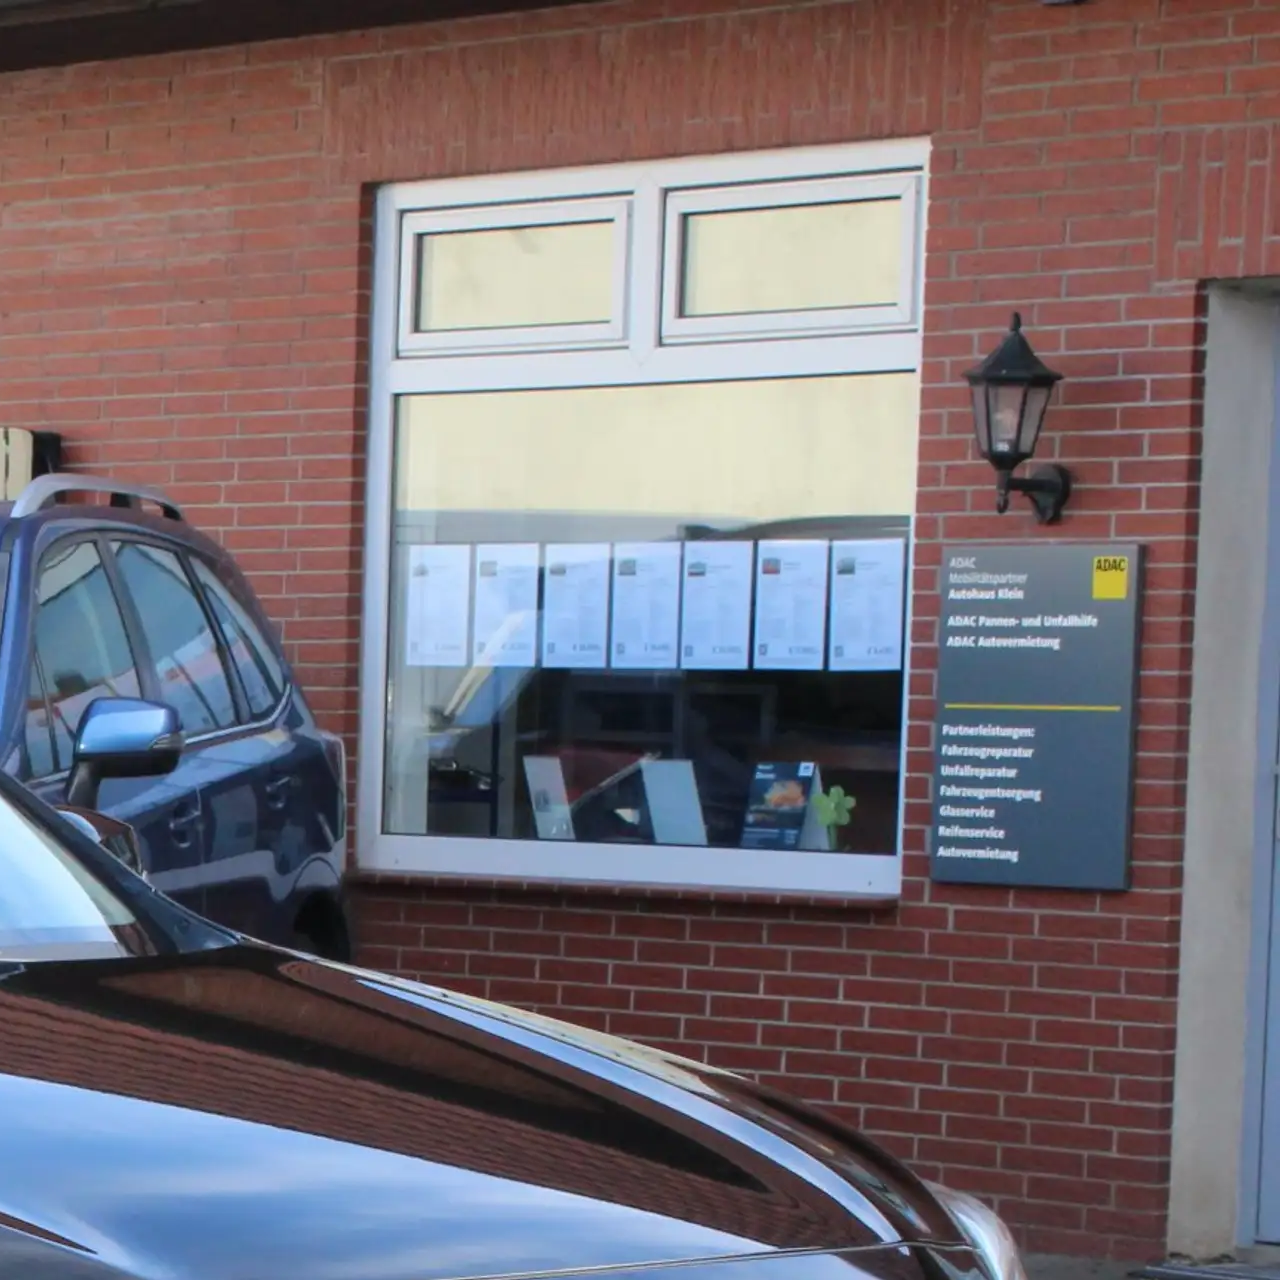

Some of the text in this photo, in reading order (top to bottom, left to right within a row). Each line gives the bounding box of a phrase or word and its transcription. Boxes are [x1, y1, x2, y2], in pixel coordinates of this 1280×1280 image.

[949, 557, 976, 568] ADAC
[1096, 559, 1126, 571] ADAC
[948, 588, 1024, 599] Autohaus Klein
[947, 614, 1098, 628] ADAC Pannen- und Unfallhilfe
[946, 636, 1061, 650] ADAC Autovermietung
[942, 724, 1035, 739] Partnerleistungen:
[941, 744, 1034, 759] Fahrzeugreparatur
[941, 765, 1018, 778] Unfallreparatur
[940, 785, 1042, 801] Fahrzeugentsorgung
[939, 805, 996, 818] Glasservice
[938, 826, 1005, 839] Reifenservice
[937, 846, 1019, 862] Autovermietung
